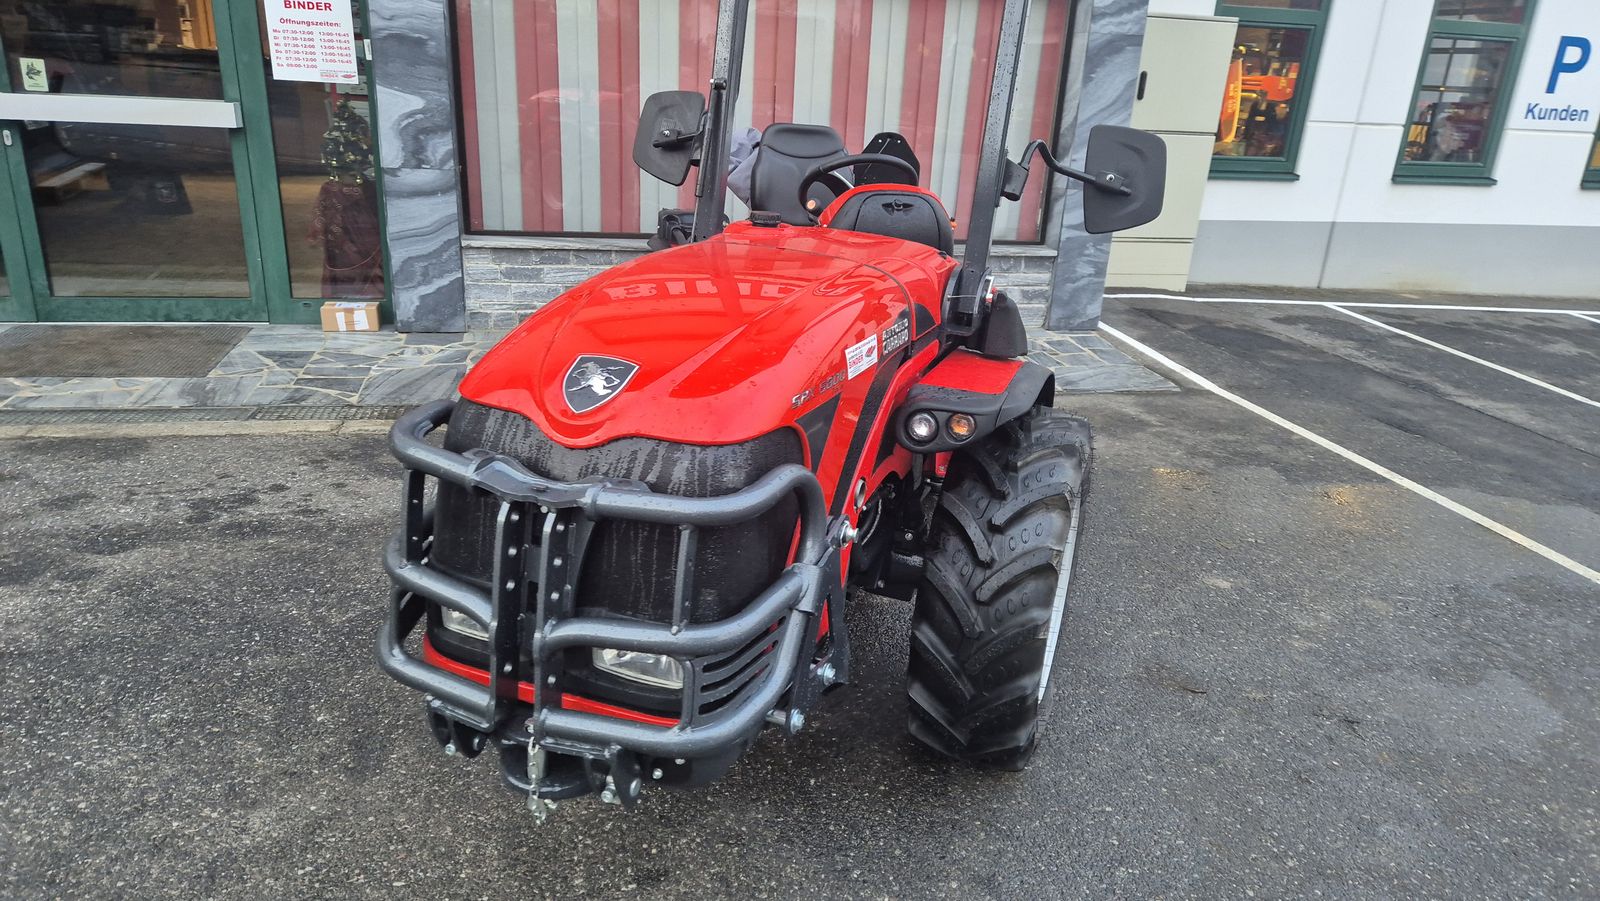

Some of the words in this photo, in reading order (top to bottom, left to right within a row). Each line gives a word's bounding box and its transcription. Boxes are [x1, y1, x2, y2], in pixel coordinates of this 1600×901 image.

[284, 0, 333, 12] BINDER
[280, 17, 341, 28] Öffnungszeiten:
[1546, 36, 1592, 94] P
[1524, 102, 1589, 122] Kunden
